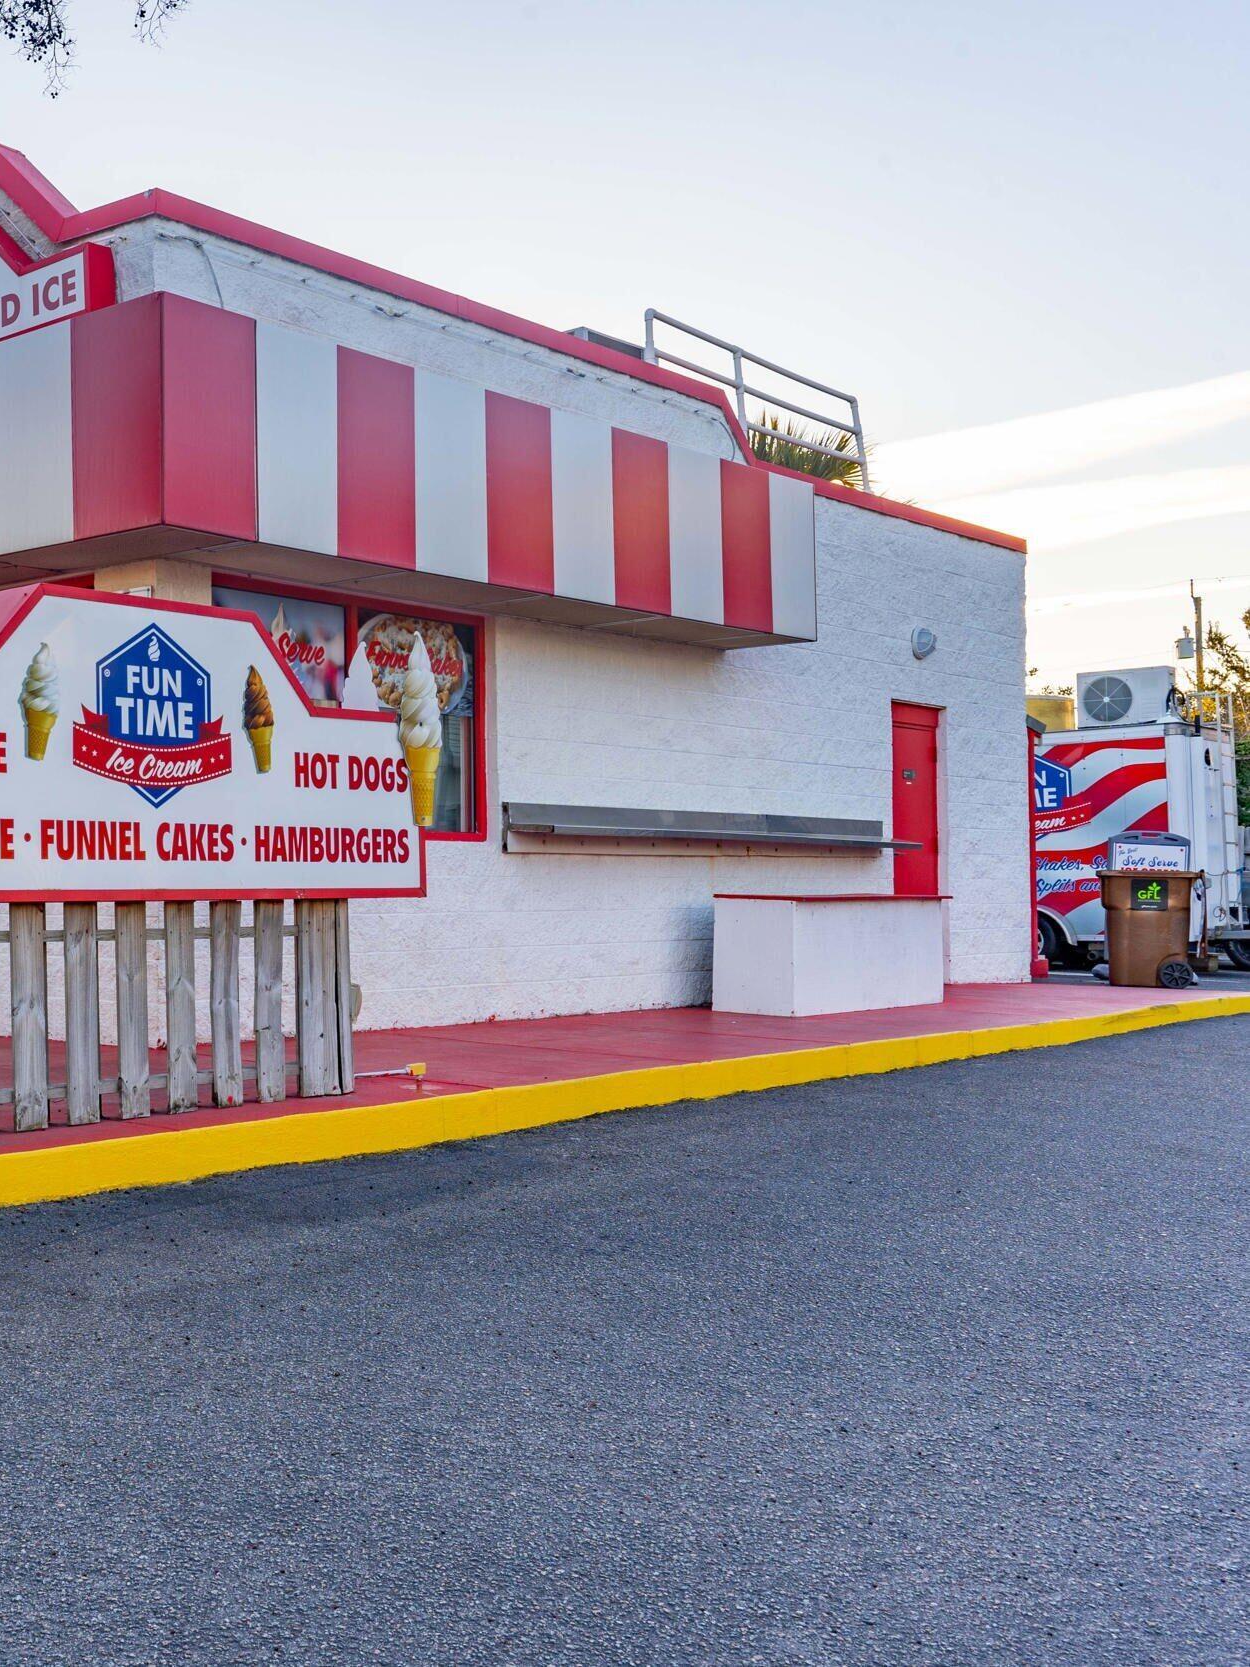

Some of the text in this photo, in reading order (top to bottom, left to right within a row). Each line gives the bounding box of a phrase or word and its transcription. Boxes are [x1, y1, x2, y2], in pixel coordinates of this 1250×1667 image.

[32, 269, 77, 317] ICE
[279, 631, 326, 666] Serve
[126, 664, 182, 698] FUN
[115, 696, 194, 739] TIME
[105, 747, 203, 779] Ice Cream
[294, 752, 409, 793] HOT DOGS
[1035, 815, 1067, 830] eam
[39, 819, 146, 861] FUNNEL
[156, 822, 234, 862] CAKES
[254, 825, 410, 864] HAMBURGERS
[1123, 855, 1179, 868] Soft Serve
[1137, 886, 1161, 900] GFL
